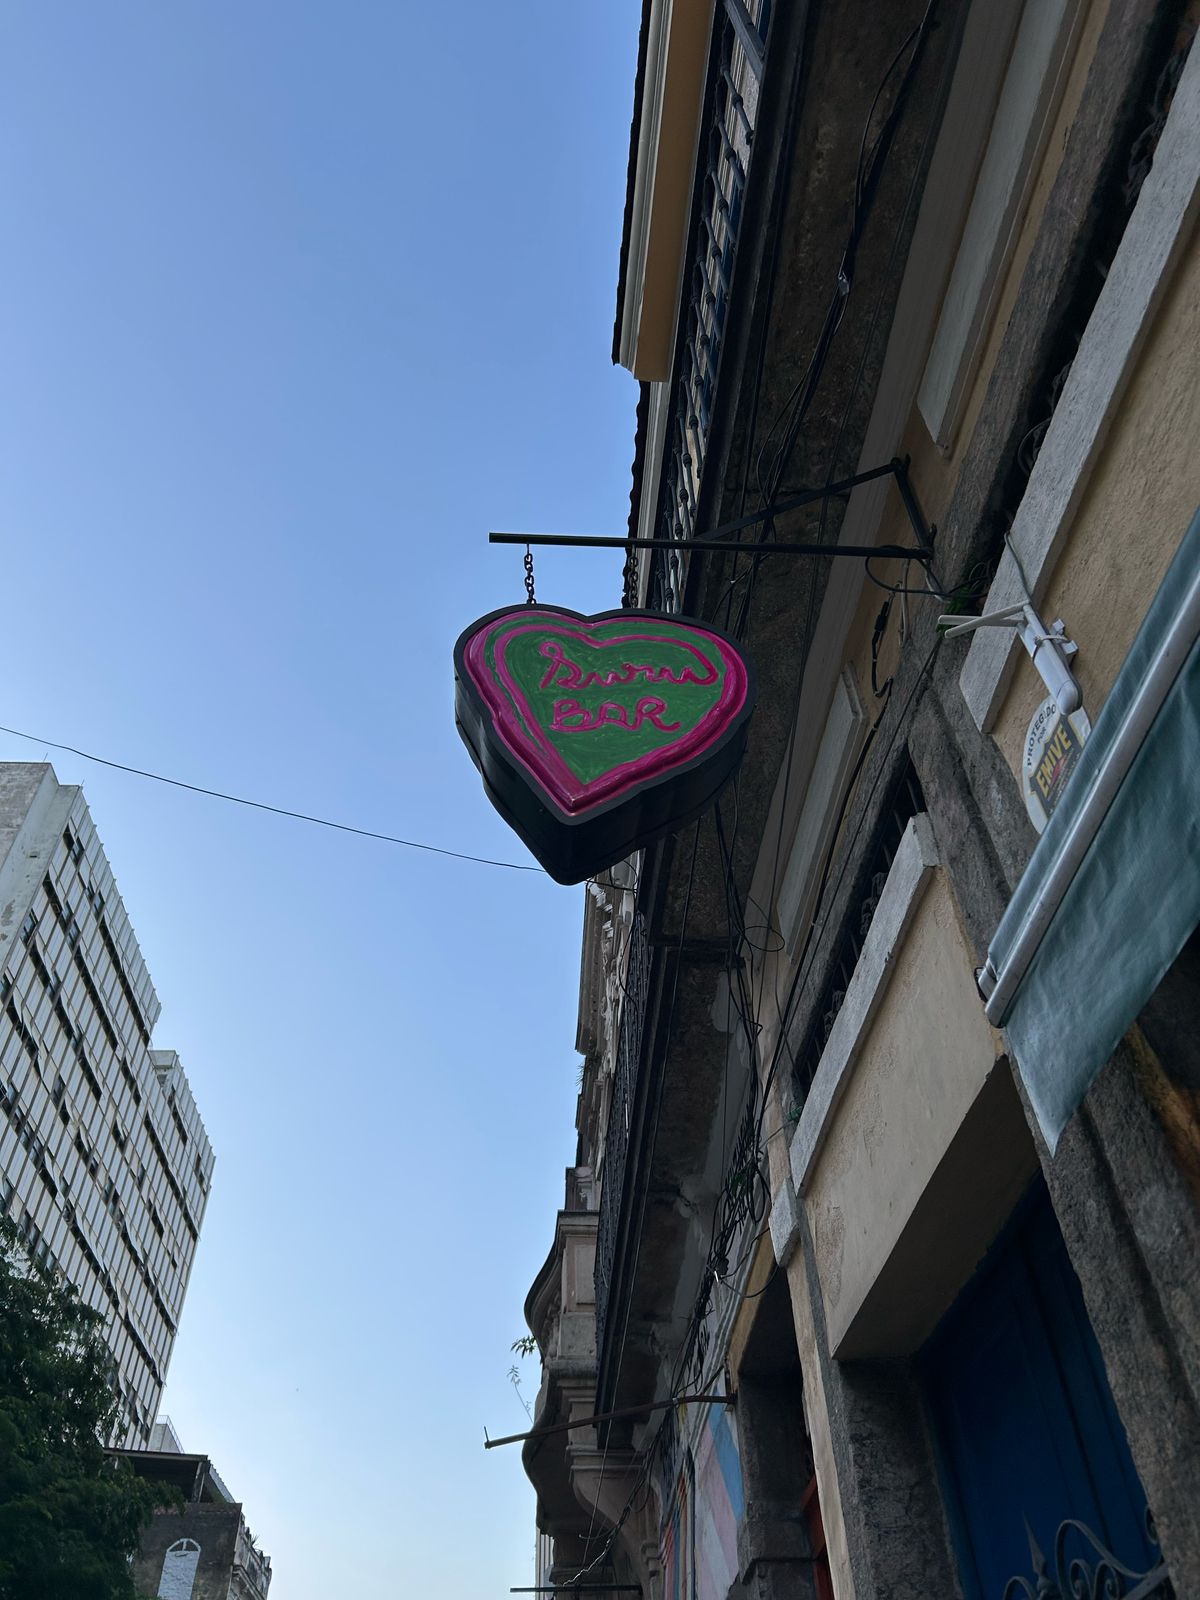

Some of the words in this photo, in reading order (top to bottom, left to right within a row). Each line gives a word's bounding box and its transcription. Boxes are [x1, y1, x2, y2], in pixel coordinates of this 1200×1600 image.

[549, 695, 682, 732] BAR
[1027, 703, 1057, 766] PROTEGIDO
[1036, 724, 1073, 798] EMIVE
